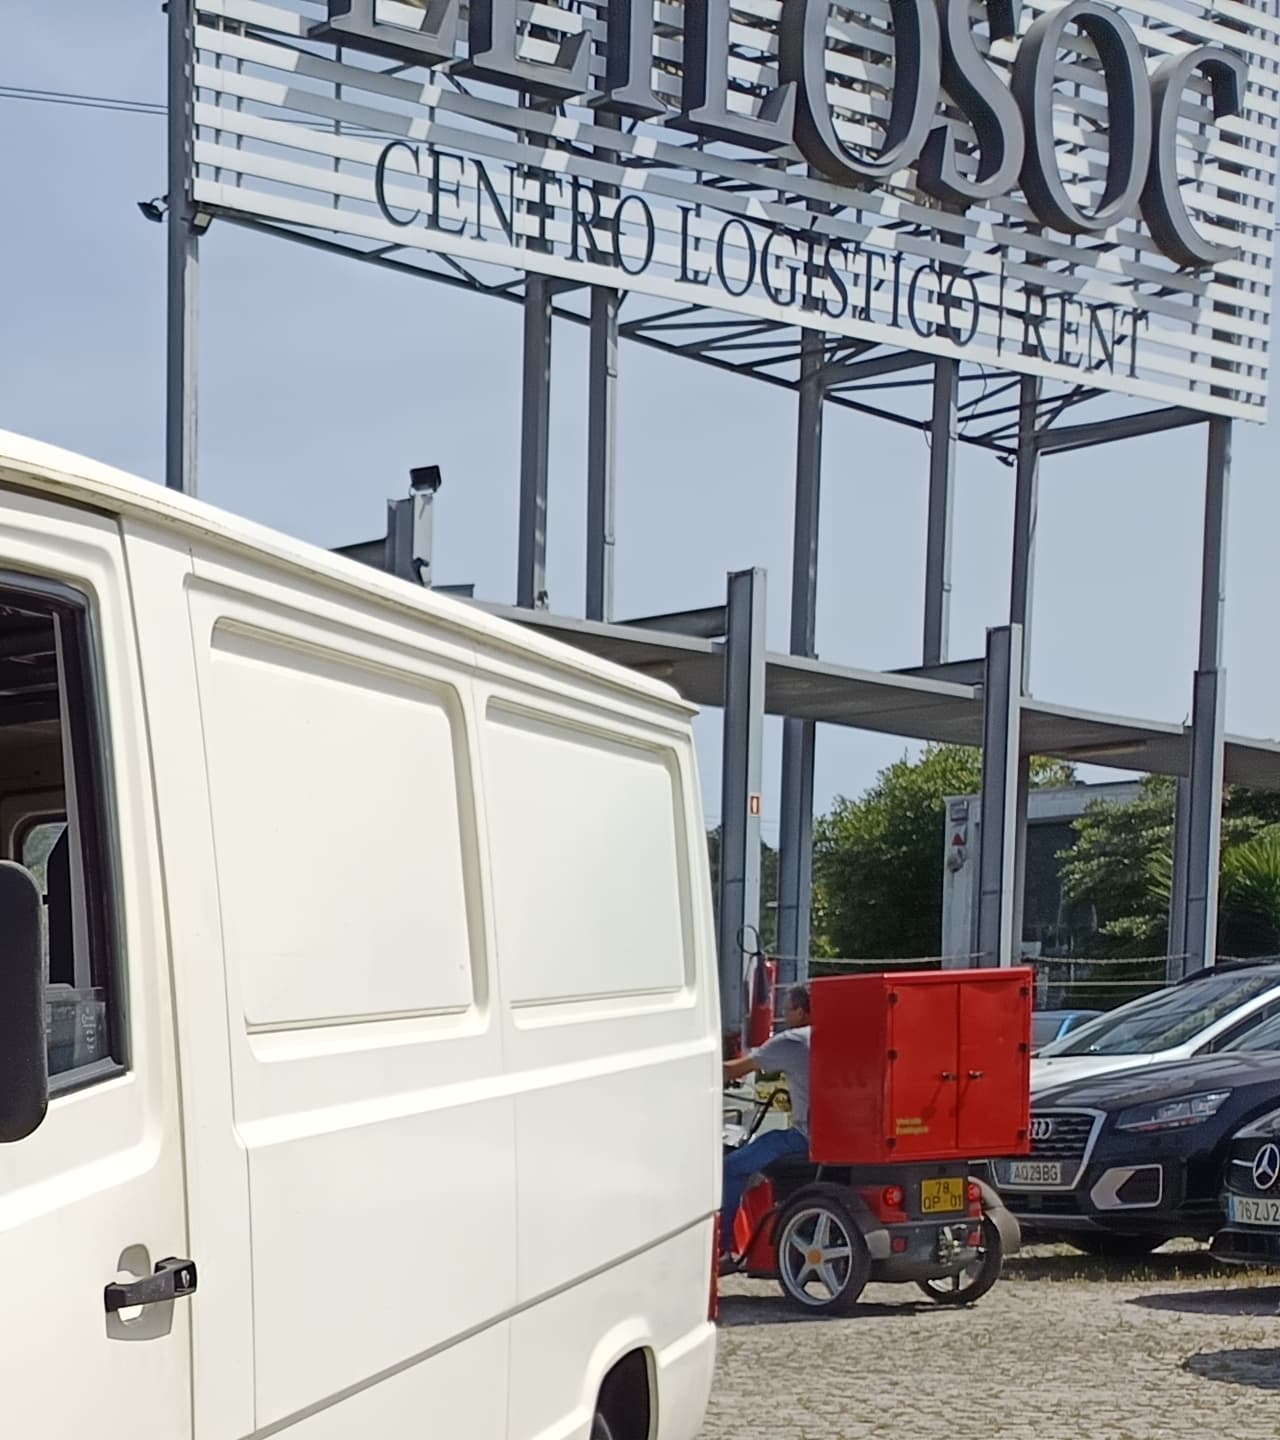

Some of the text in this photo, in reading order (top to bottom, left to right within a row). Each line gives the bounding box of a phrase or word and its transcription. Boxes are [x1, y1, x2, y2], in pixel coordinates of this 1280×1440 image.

[308, 0, 1246, 267] LOSOC
[375, 141, 655, 275] CENTRO
[1016, 285, 1150, 379] RENT
